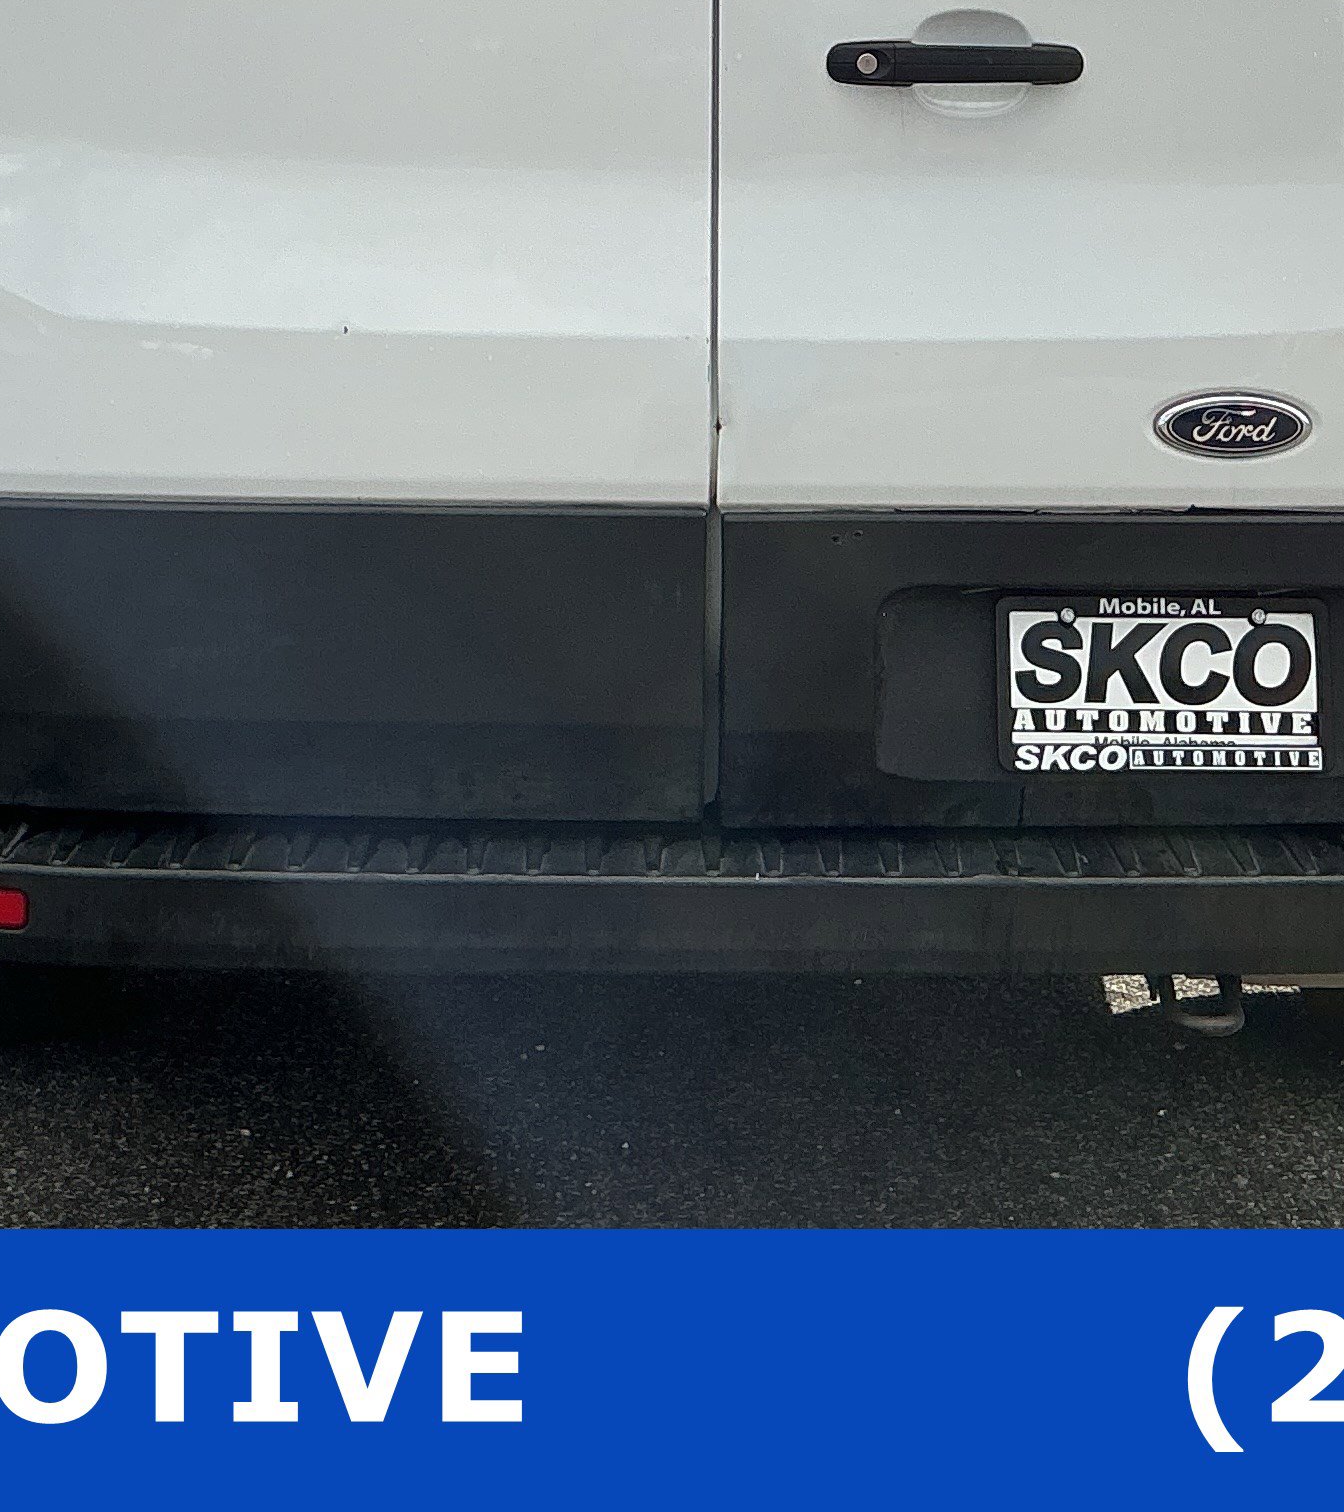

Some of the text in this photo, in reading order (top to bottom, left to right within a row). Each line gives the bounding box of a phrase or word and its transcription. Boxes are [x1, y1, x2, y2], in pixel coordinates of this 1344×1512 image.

[1193, 408, 1277, 442] Ford
[1099, 597, 1222, 617] Mobile, AL
[1015, 620, 1312, 705] SKCO
[1013, 709, 1312, 734] AUTOMOTIVE
[1014, 745, 1320, 771] SKCO AUTOMOTIVE
